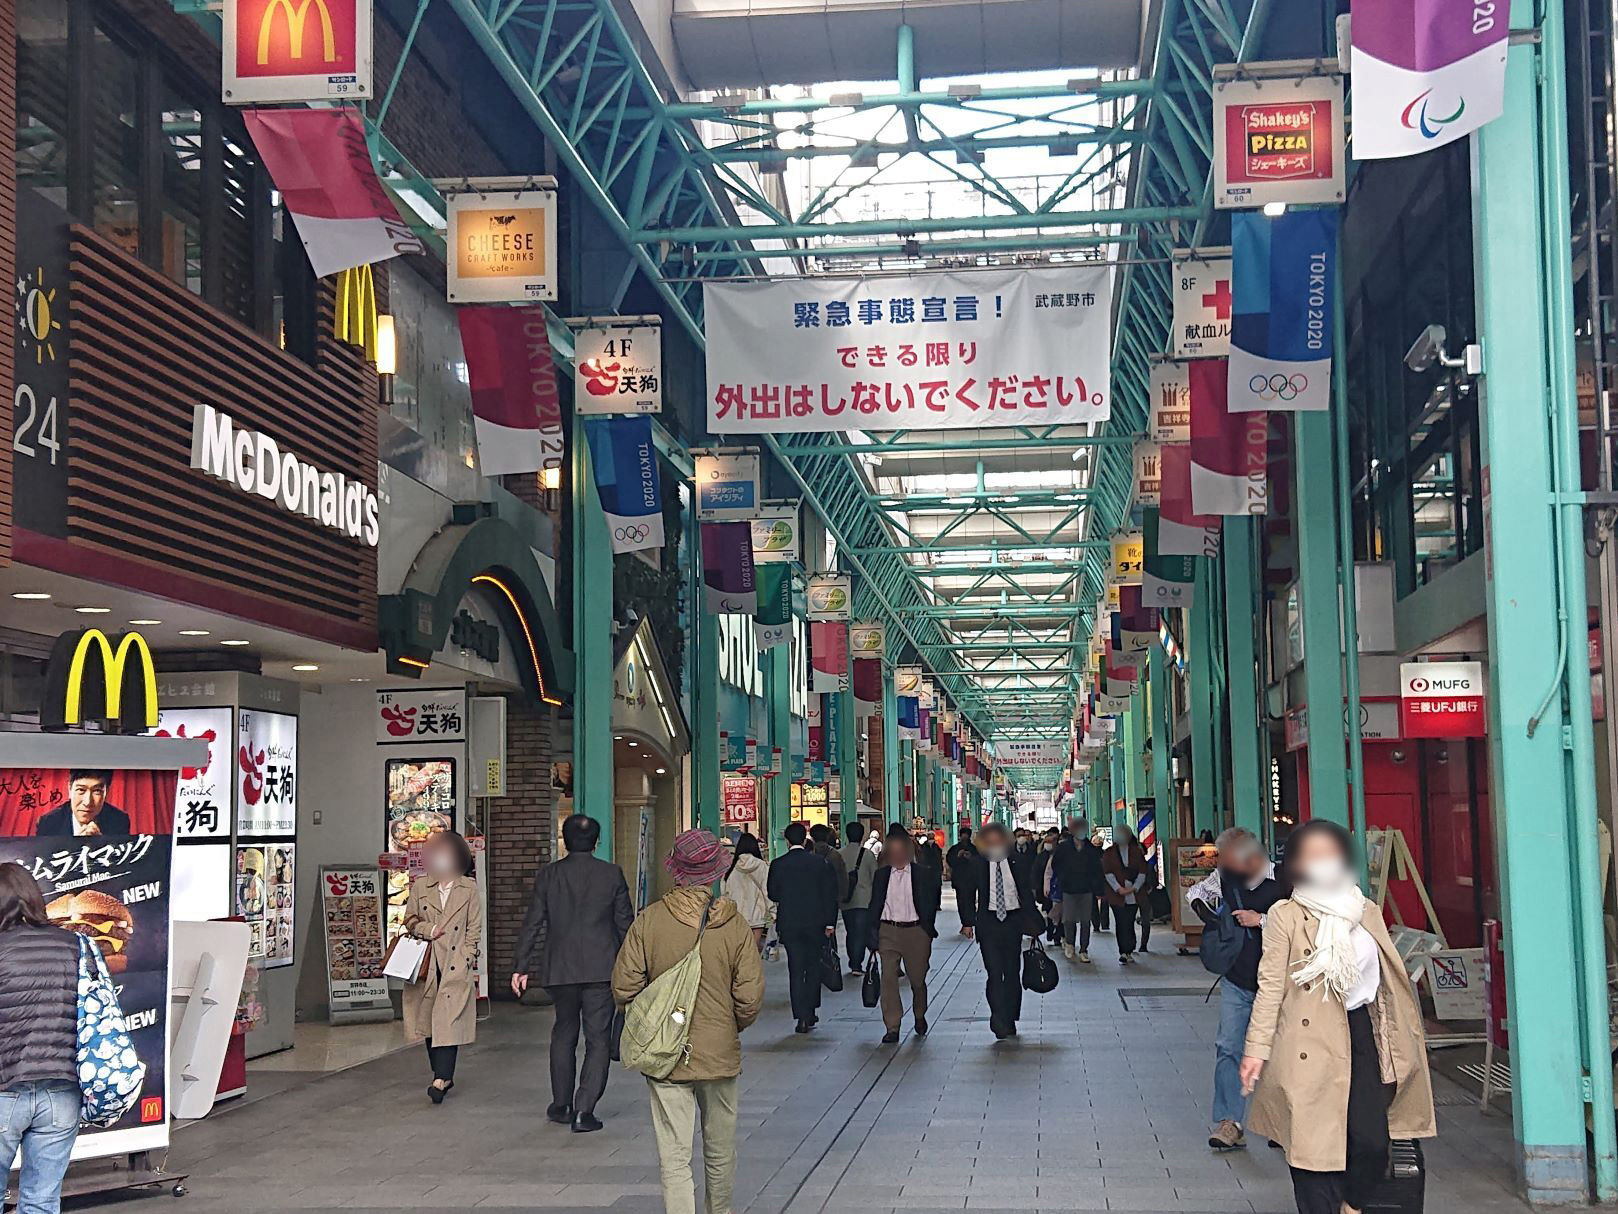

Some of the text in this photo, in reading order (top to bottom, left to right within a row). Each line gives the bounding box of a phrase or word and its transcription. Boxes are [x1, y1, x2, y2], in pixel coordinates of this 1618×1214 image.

[336, 84, 348, 92] 59
[1248, 111, 1310, 128] Shakey's
[1251, 156, 1308, 171] シェーキーズ
[467, 233, 534, 251] CHEESE
[467, 252, 534, 263] CRAFT WORKS
[1181, 278, 1197, 290] 8F
[1034, 292, 1097, 309] 武蔵野市
[1307, 252, 1326, 350] TOKYO 2020
[793, 295, 1003, 328] 緊急事態宣言！
[603, 339, 632, 357] 4F
[836, 342, 978, 369] できる限り
[521, 303, 565, 469] TOKYO 2020
[618, 375, 658, 394] 天狗
[714, 374, 1104, 420] 外出はしないでください。
[13, 384, 60, 465] 24
[190, 403, 379, 547] McDonald's
[638, 443, 655, 507] TOKYO 2020
[1247, 452, 1267, 515] 2020
[1432, 680, 1470, 689] MUFG
[379, 694, 393, 704] 4F
[1410, 701, 1478, 713] 三菱UFJ銀行
[241, 714, 250, 732] 4F
[417, 713, 461, 735] 天狗
[264, 765, 294, 804] 天狗
[431, 774, 440, 813] ステーキ
[18, 788, 63, 811] 楽しめ
[91, 871, 111, 884] Mac
[349, 880, 375, 894] 天狗
[122, 881, 161, 905] NEW
